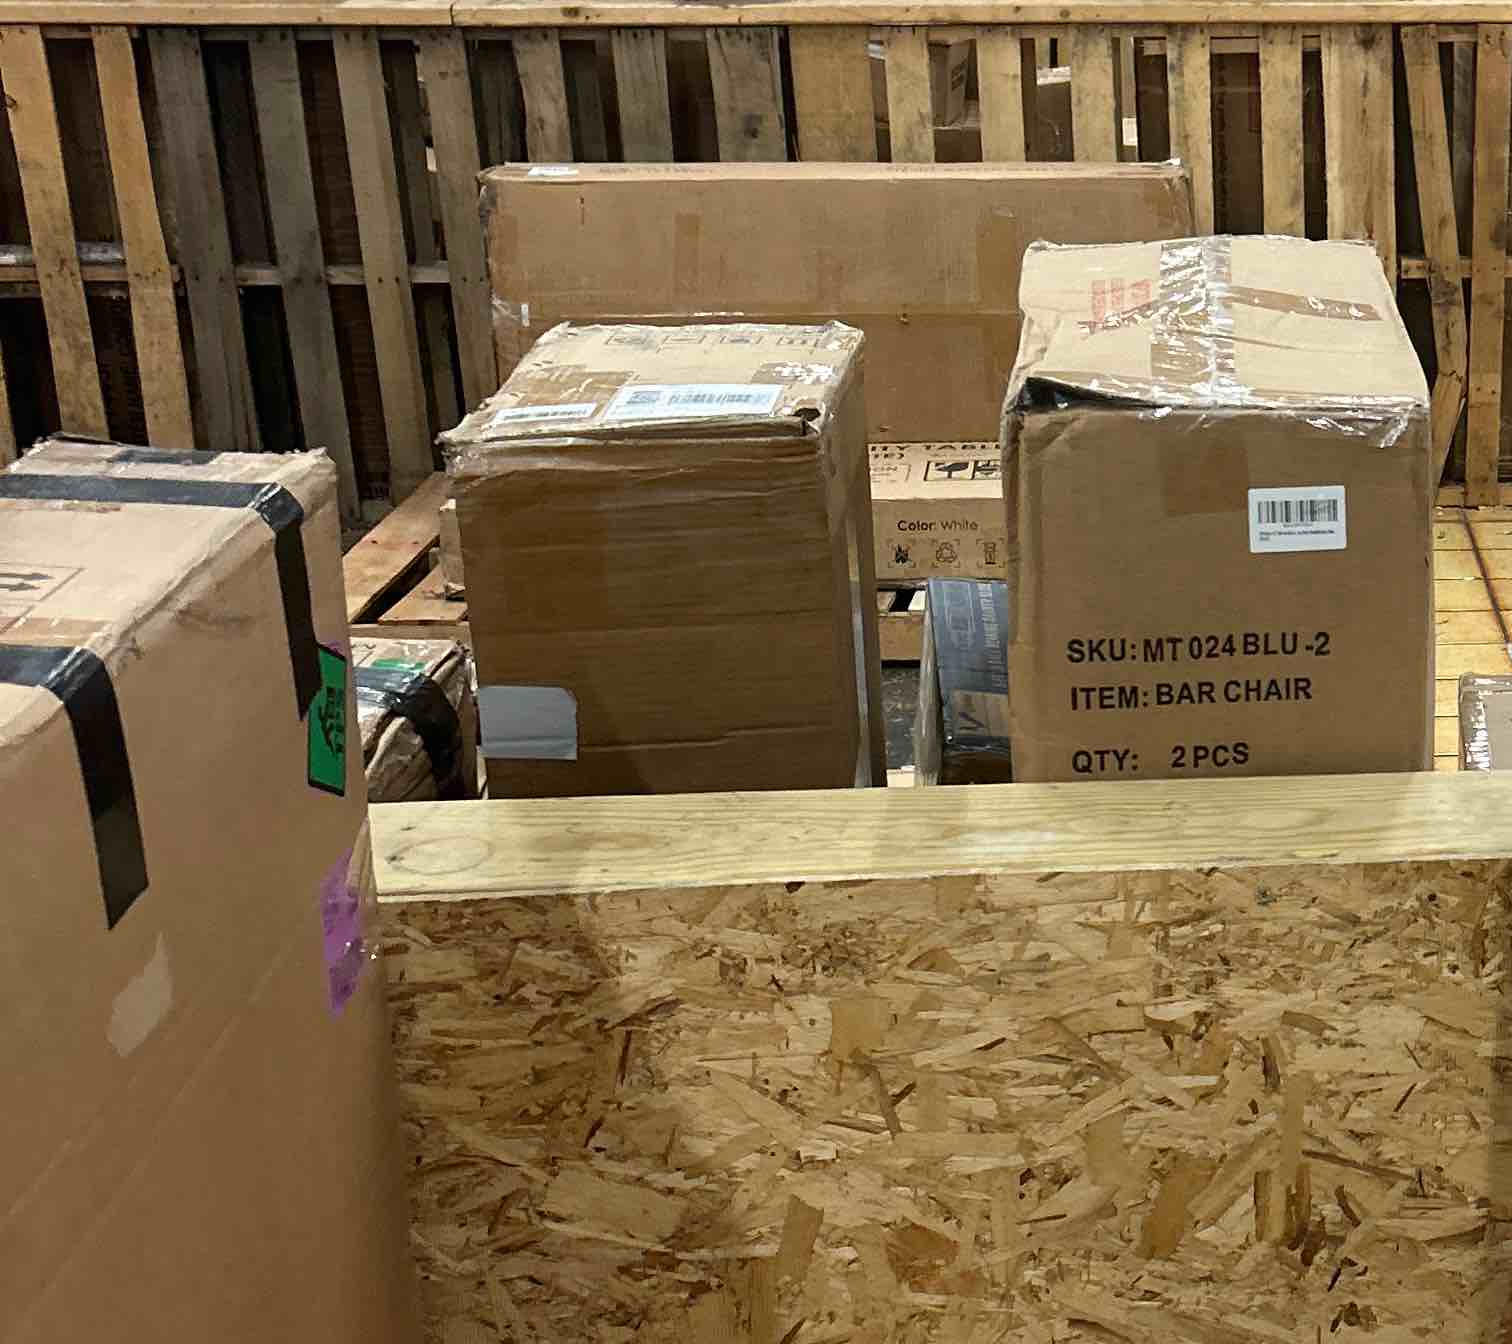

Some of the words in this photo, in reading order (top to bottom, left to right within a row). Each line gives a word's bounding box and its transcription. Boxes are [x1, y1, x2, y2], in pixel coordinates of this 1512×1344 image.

[897, 520, 937, 531] Color:
[940, 519, 979, 531] White
[1067, 638, 1137, 663] SKU:
[1071, 686, 1148, 711] ITEM:
[1155, 681, 1217, 706] BAR
[1223, 677, 1313, 704] CHAIR
[1072, 748, 1139, 774] QTY:
[1171, 745, 1187, 768] 2
[1193, 742, 1249, 769] PCS
